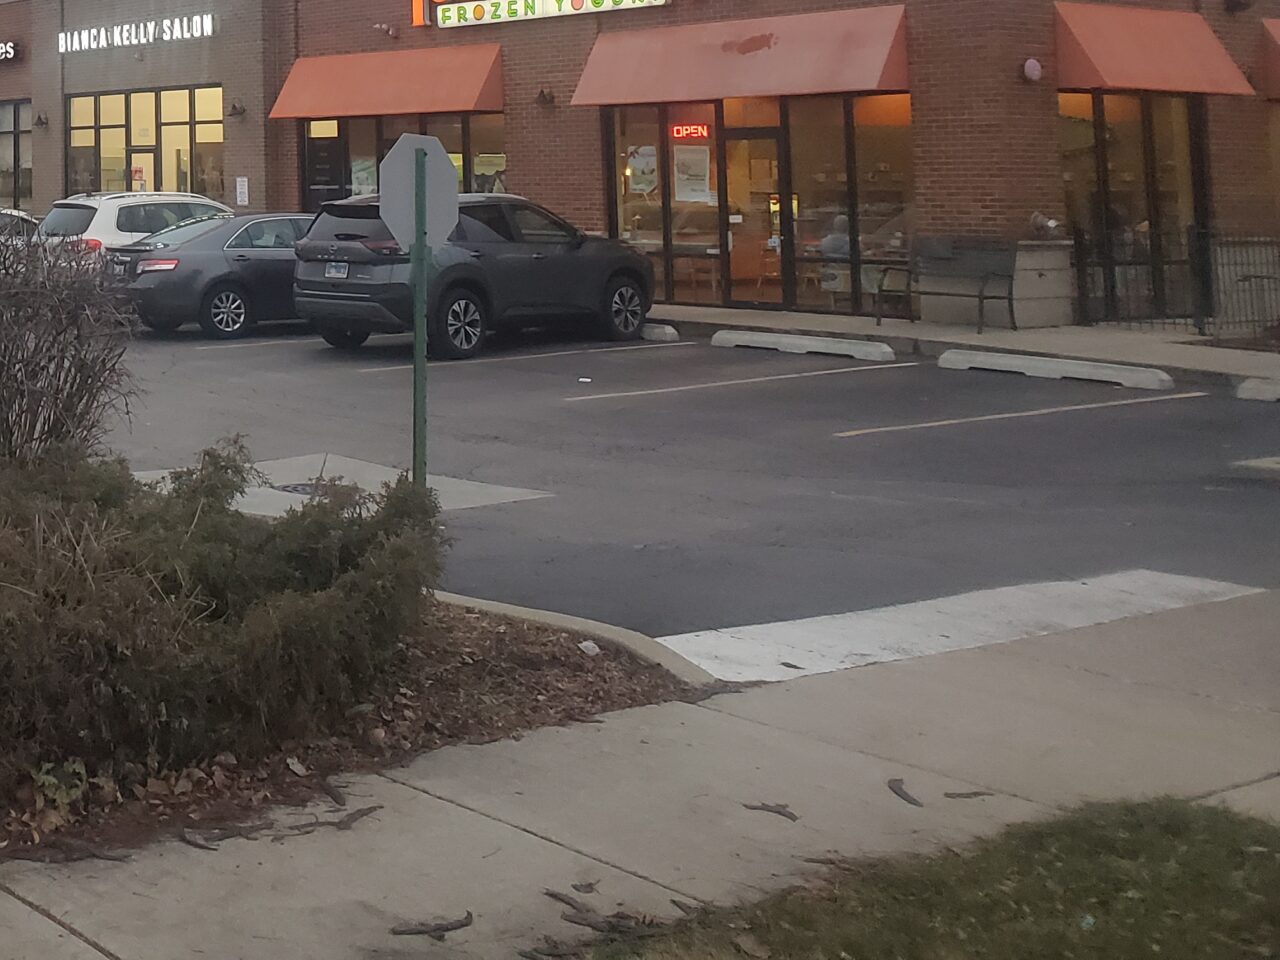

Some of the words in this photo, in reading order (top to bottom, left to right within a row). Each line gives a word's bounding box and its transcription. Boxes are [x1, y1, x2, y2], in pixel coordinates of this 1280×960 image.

[58, 27, 108, 53] BIANCA
[112, 20, 156, 47] KELLY
[163, 14, 213, 41] SALON
[673, 125, 708, 138] OPEN
